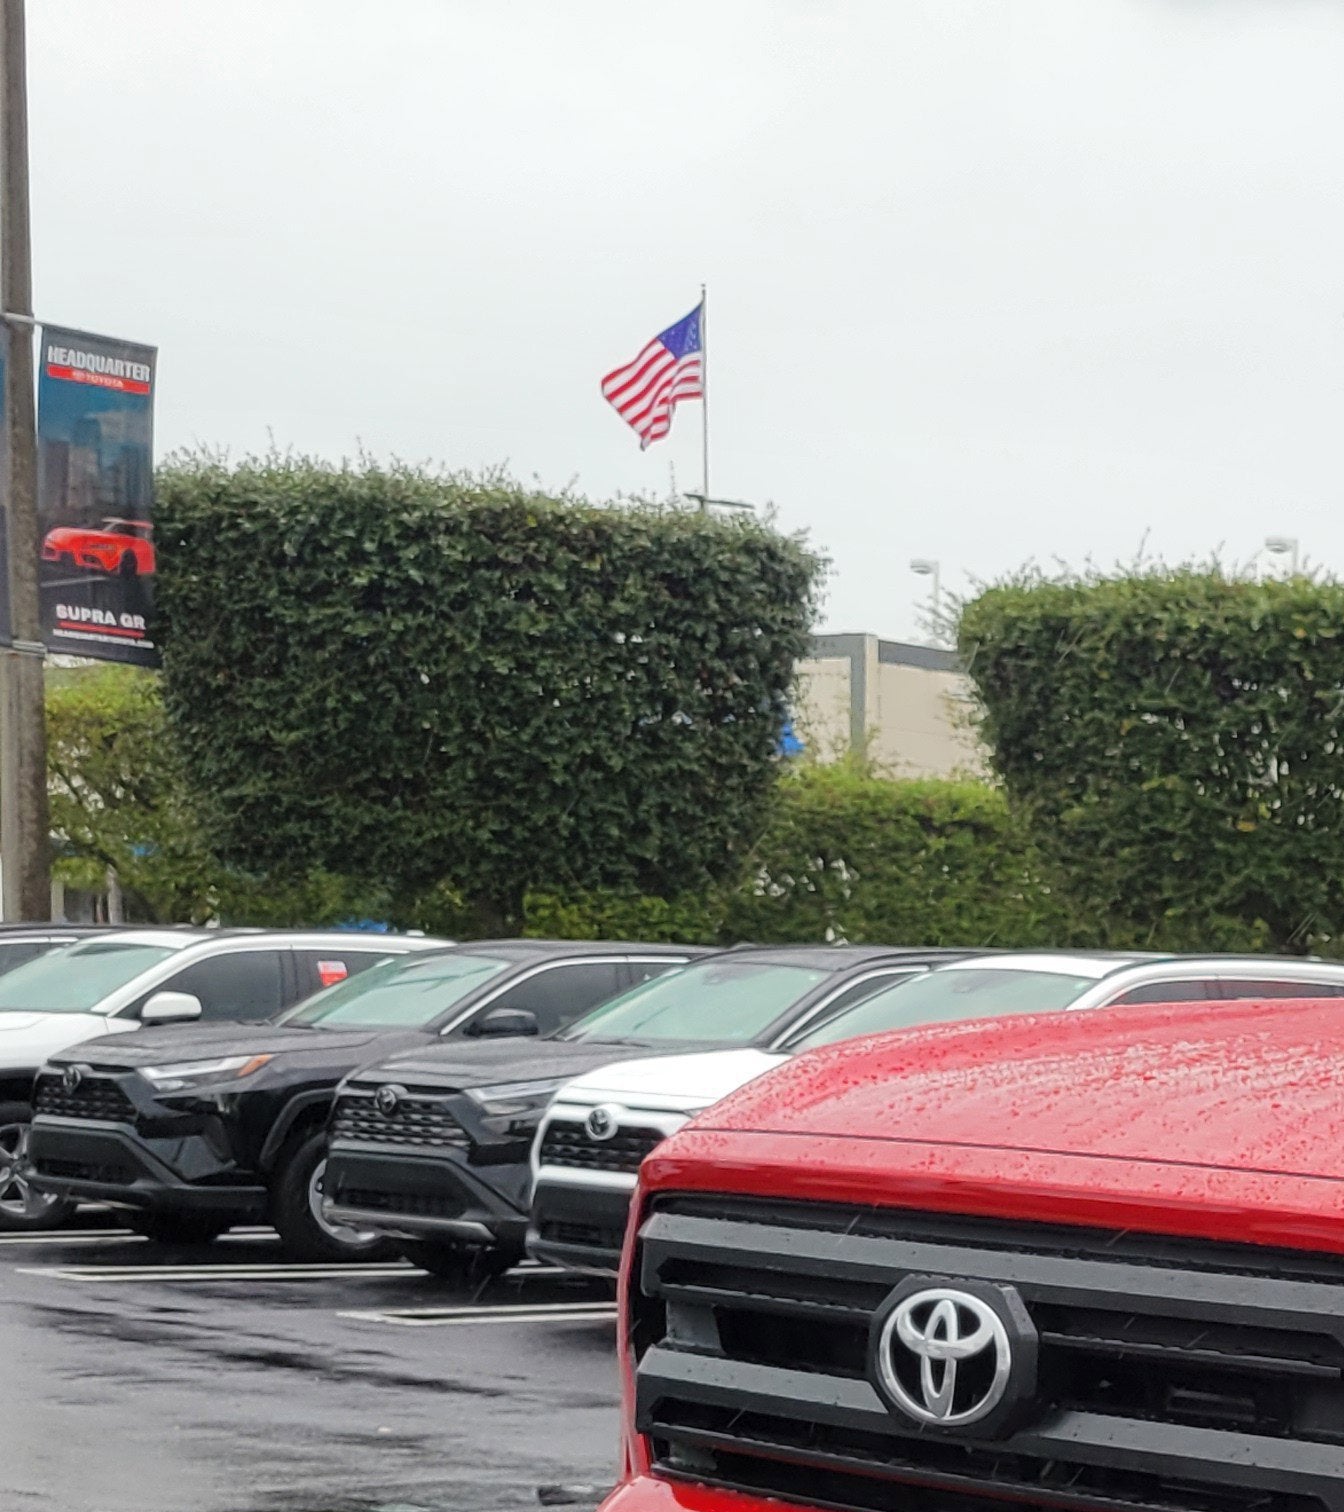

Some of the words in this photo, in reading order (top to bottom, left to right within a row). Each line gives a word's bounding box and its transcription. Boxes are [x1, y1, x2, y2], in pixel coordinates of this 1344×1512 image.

[48, 345, 150, 382] HEADQUARTER
[56, 604, 117, 626] SUPRA
[120, 613, 146, 630] GR
